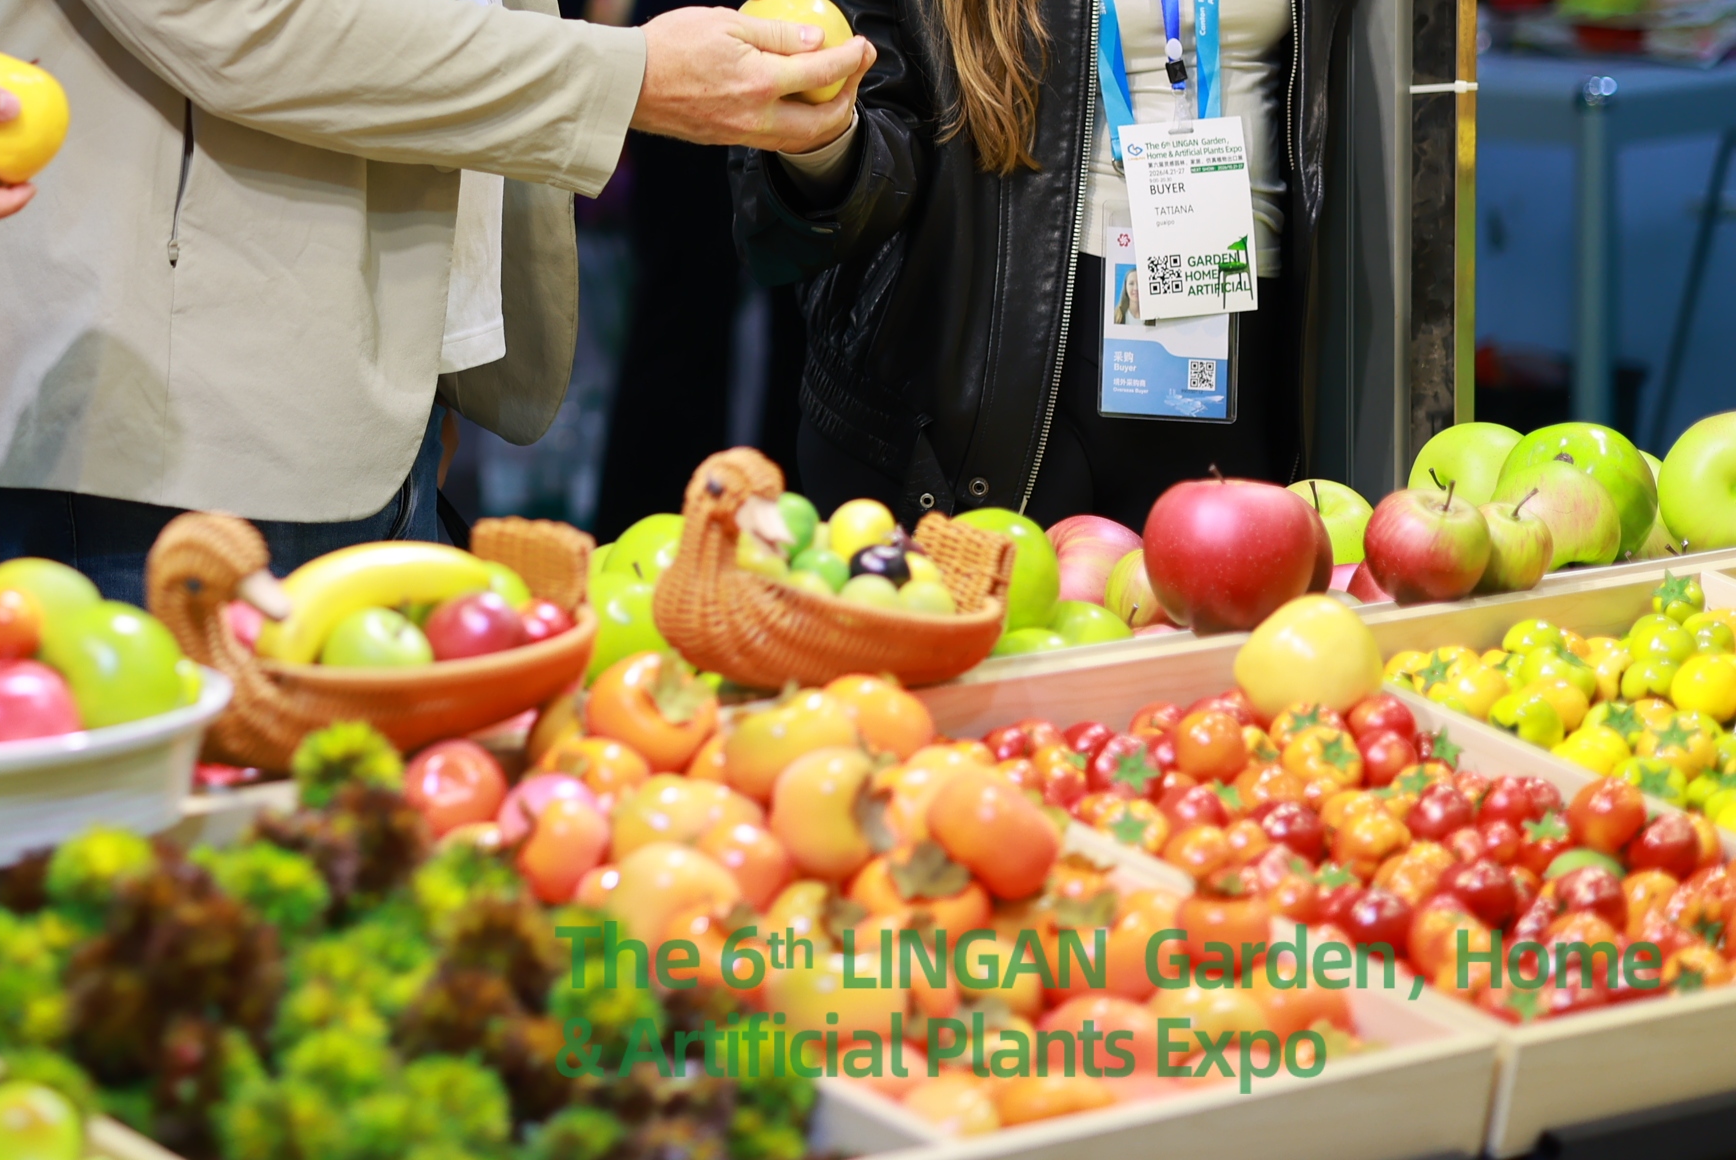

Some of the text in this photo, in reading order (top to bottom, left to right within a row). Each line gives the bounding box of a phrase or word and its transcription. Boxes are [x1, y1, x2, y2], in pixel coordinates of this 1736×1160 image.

[1199, 7, 1207, 36] Canton
[1145, 142, 1160, 150] The
[1161, 141, 1171, 149] 6th
[1172, 139, 1199, 148] LINGAN
[1146, 151, 1168, 160] Home
[1168, 150, 1174, 158] &
[1174, 148, 1203, 157] Artificial
[1204, 146, 1225, 155] Plants
[1225, 145, 1243, 155] Expo
[1149, 182, 1186, 195] BUYER
[1154, 204, 1194, 216] TATIANA
[1187, 252, 1238, 267] GARDEN
[1185, 269, 1219, 282] HOME
[1187, 280, 1252, 297] ARTIFICIAL
[1113, 351, 1134, 363] 采购
[1113, 363, 1137, 373] Buyer
